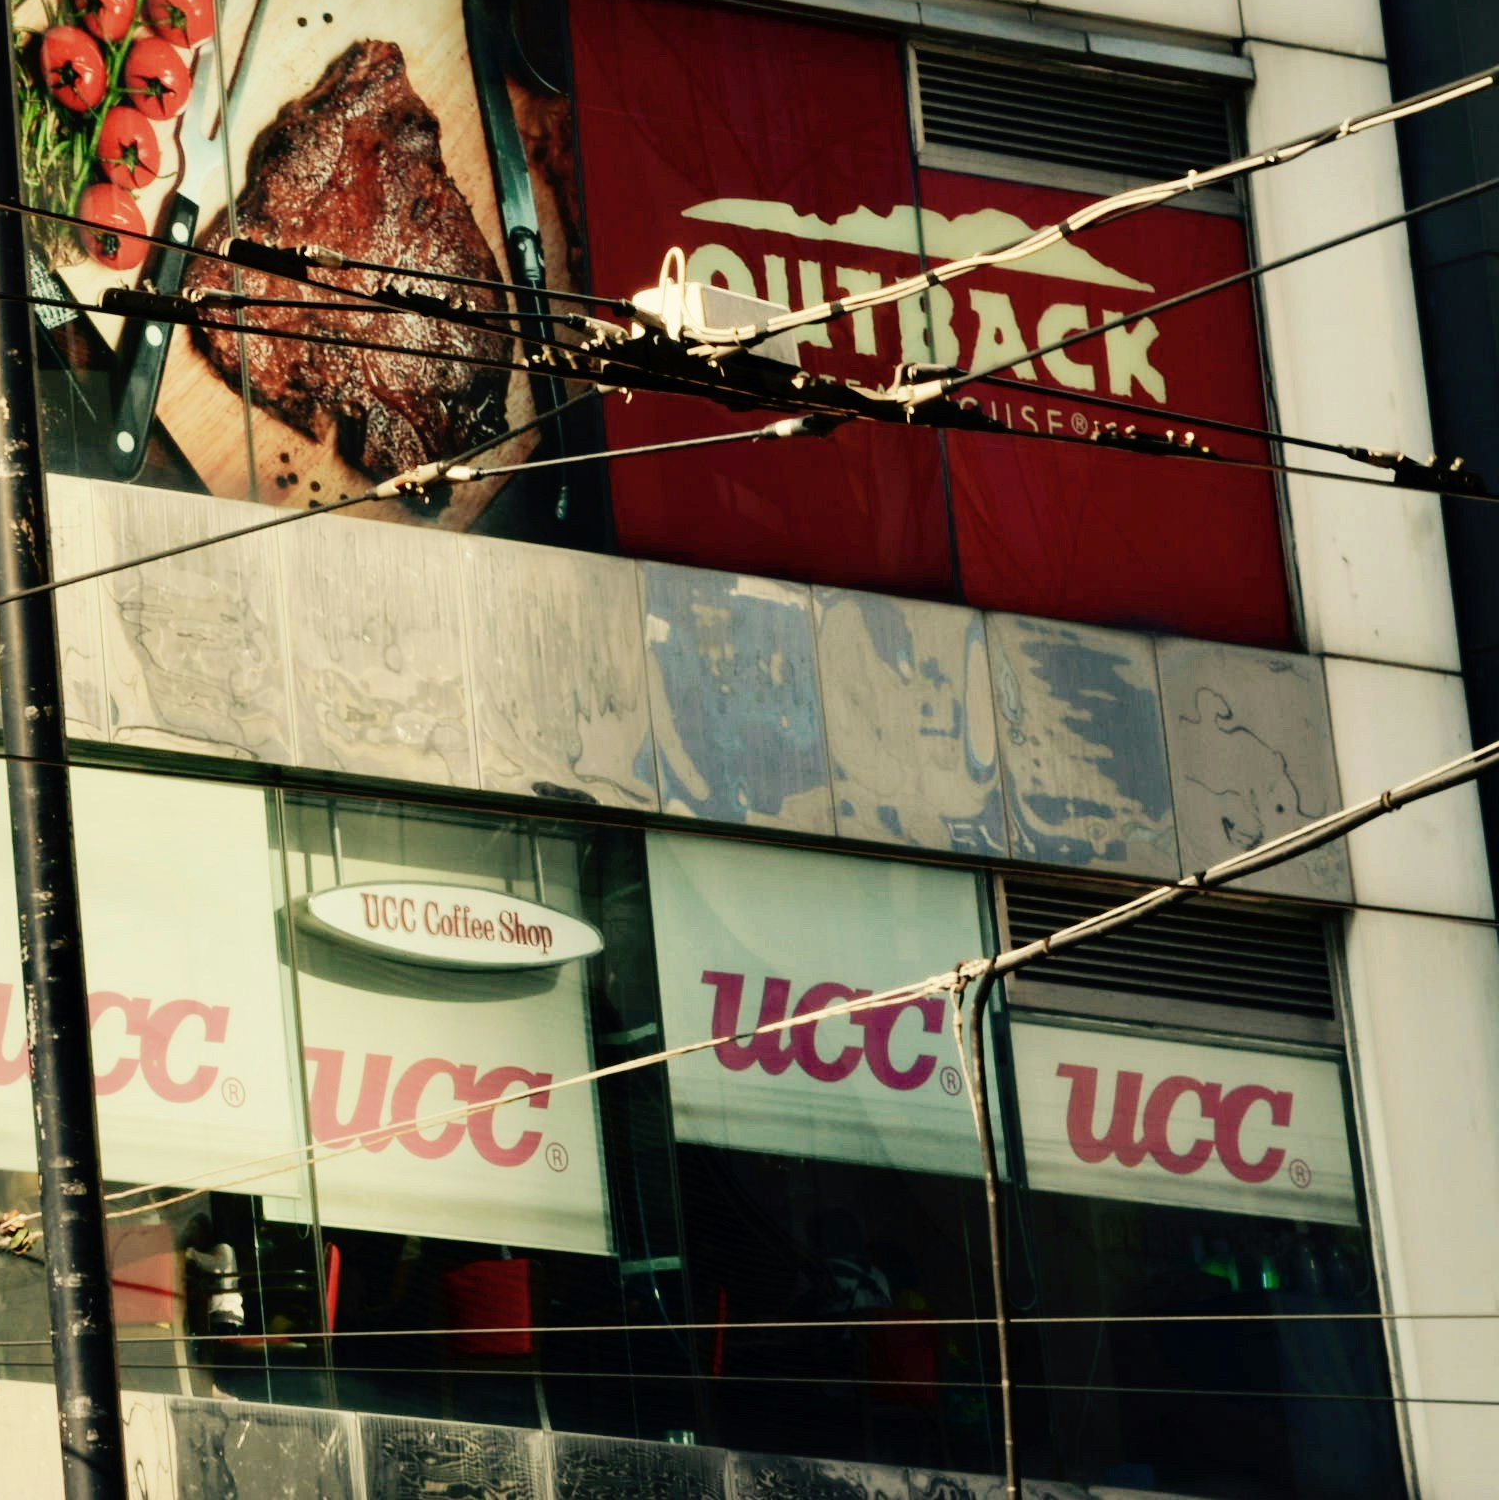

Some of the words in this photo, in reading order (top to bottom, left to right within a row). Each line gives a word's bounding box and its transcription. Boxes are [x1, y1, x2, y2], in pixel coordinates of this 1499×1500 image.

[360, 892, 417, 933] UCC
[424, 900, 496, 942] Coffee
[498, 909, 554, 954] Shop
